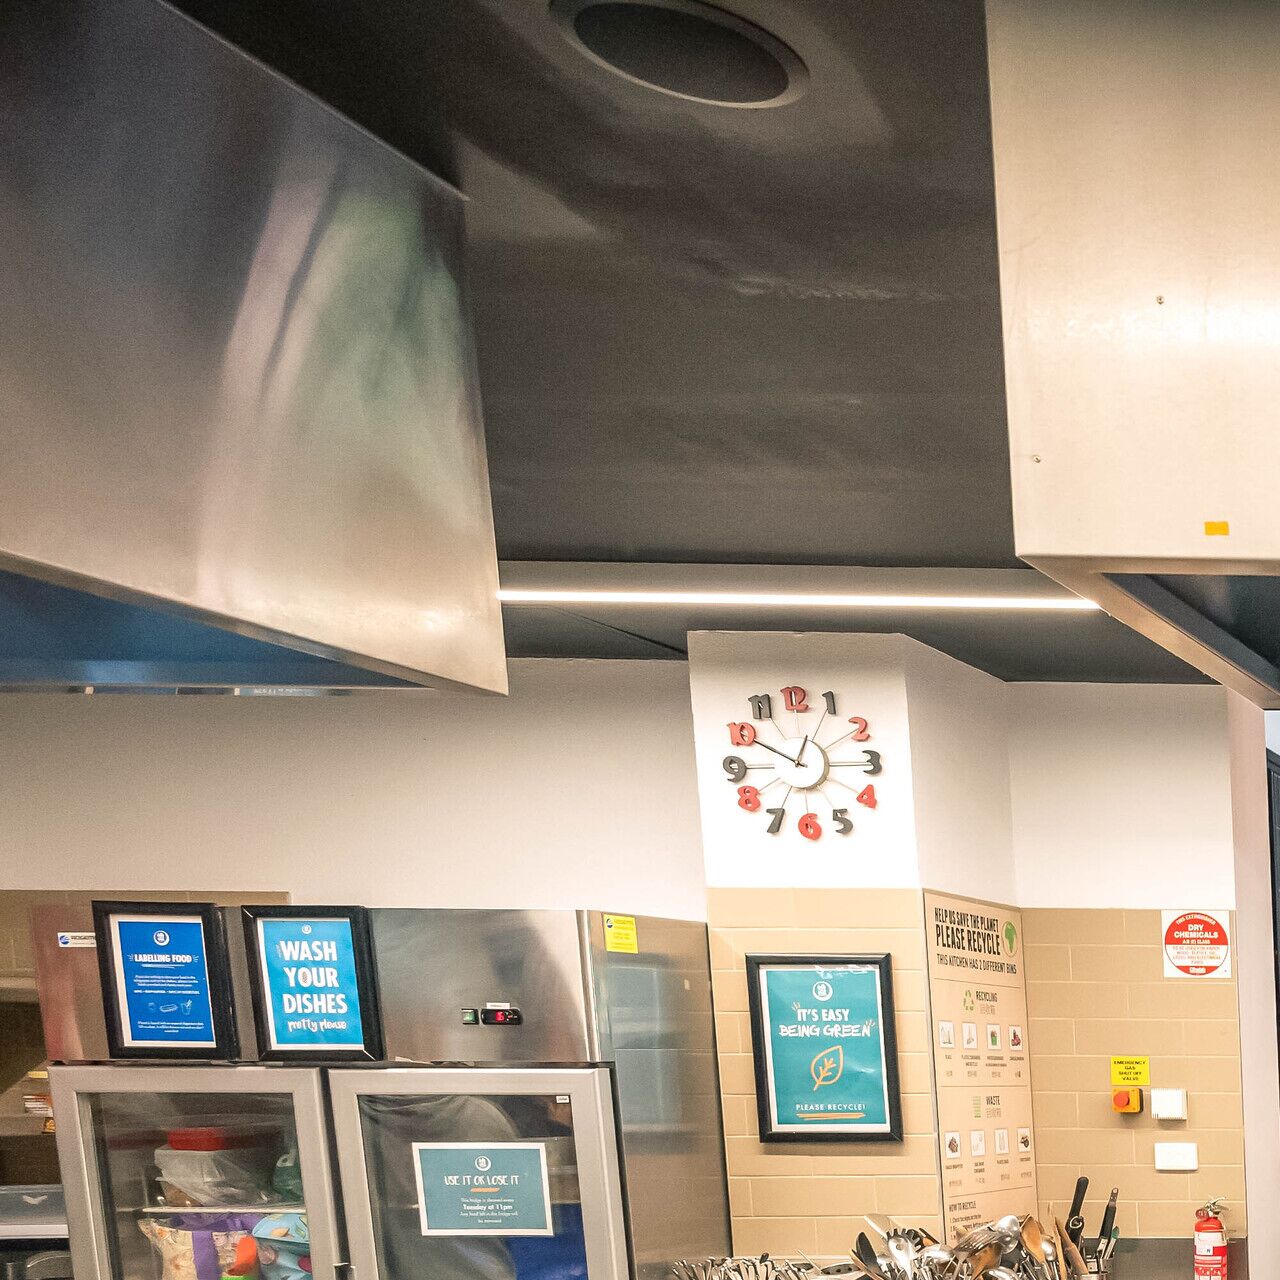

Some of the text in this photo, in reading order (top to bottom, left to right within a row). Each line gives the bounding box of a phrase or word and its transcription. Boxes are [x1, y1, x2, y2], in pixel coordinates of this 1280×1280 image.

[748, 693, 772, 719] 11
[780, 685, 809, 713] 12
[821, 690, 836, 715] 1
[726, 722, 757, 746] 10
[848, 716, 871, 742] 2
[722, 755, 747, 782] 9
[861, 750, 882, 775] 3
[737, 785, 761, 812] 8
[856, 784, 877, 809] 4
[766, 807, 785, 834] 7
[798, 813, 822, 840] 6
[832, 809, 854, 834] 5
[935, 907, 999, 933] HELP US SAVE THE PLANET
[936, 924, 1001, 955] PLEASE RECYCLE
[1174, 931, 1219, 939] CHEMICALS
[134, 954, 192, 963] LABELLING FOOD
[279, 940, 338, 961] WASH
[937, 953, 948, 966] THIS
[949, 955, 969, 968] KITCHEN
[969, 958, 978, 970] HAS
[983, 960, 1006, 973] DIFFERENT
[1007, 963, 1017, 974] BINS
[283, 967, 340, 988] YOUR
[282, 993, 348, 1014] DISHES
[976, 990, 998, 1003] RECYCLING
[288, 1018, 347, 1033] pretty please
[797, 1008, 849, 1021] IT'S EASY
[779, 1023, 871, 1037] BEING GREEN
[796, 1103, 866, 1111] PLEASE RECYCLE!
[444, 1175, 520, 1186] USE IT OR LOSE IT
[463, 1204, 486, 1212] Tuesday
